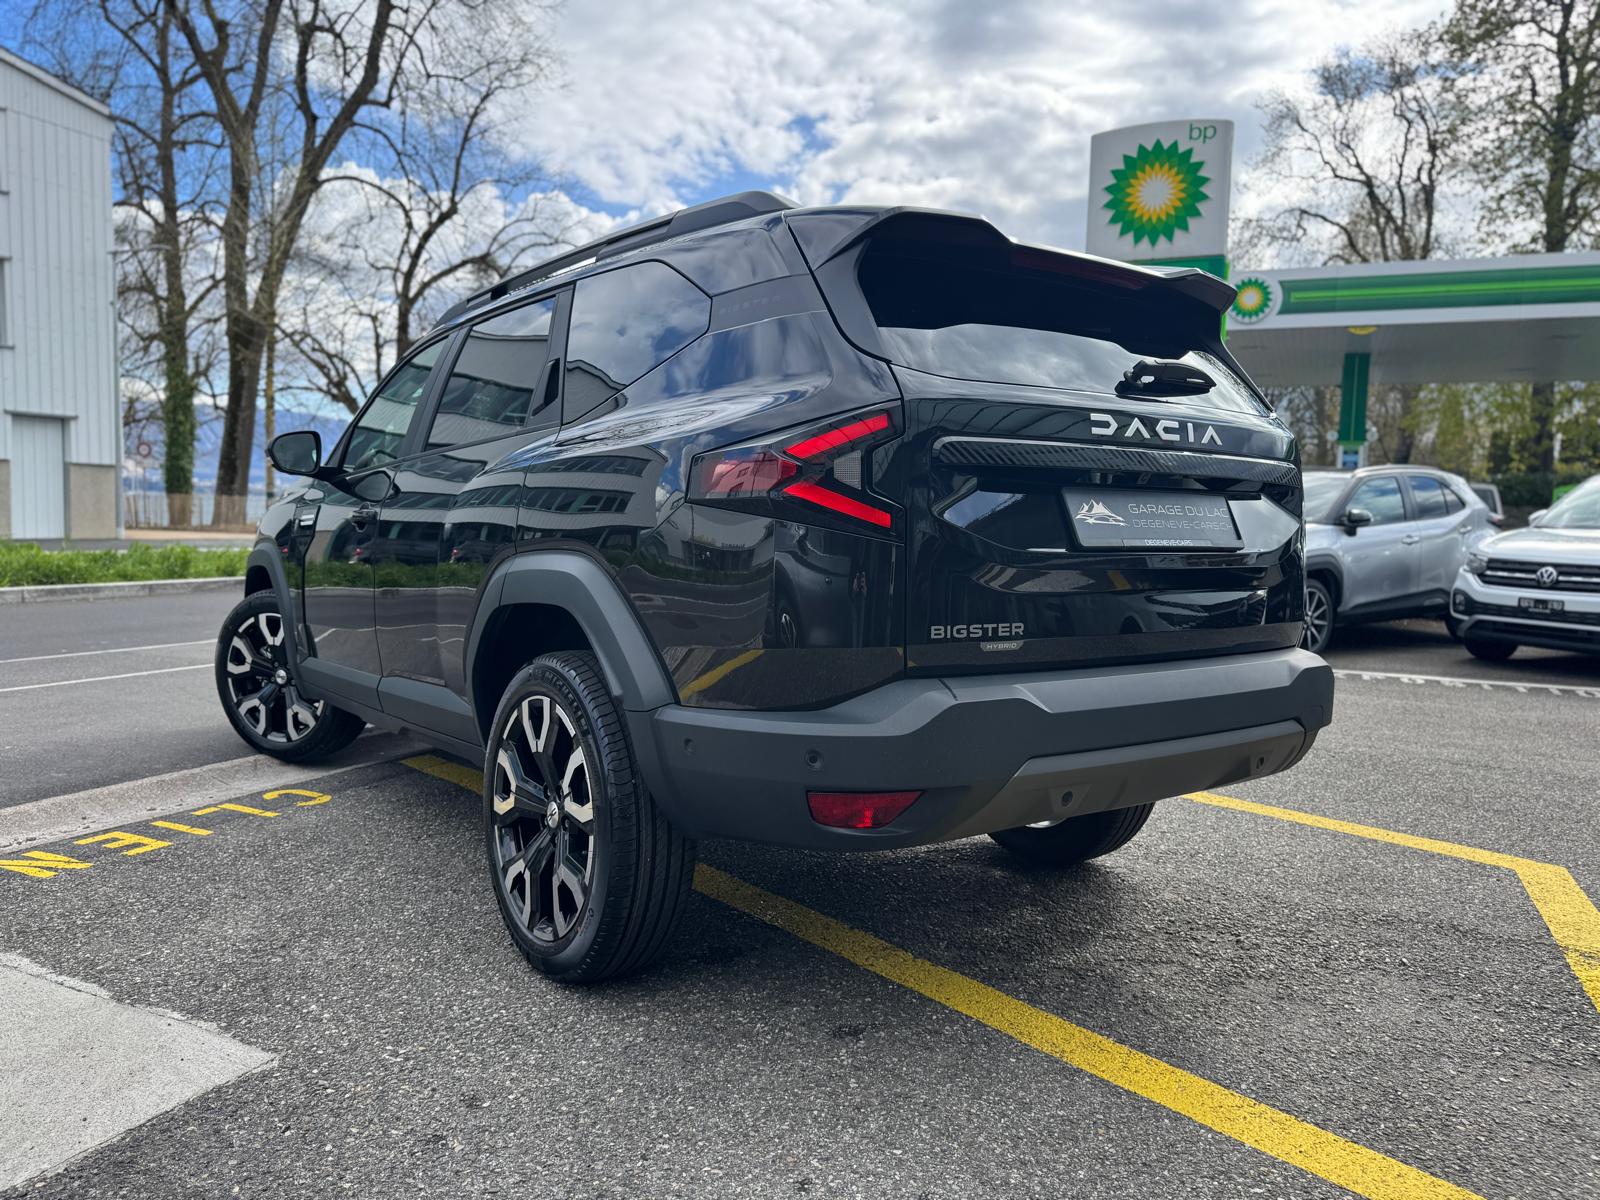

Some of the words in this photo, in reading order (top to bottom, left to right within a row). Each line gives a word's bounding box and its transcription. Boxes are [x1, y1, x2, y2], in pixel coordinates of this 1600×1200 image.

[1188, 123, 1217, 144] bp
[1090, 413, 1223, 446] DACIA
[1127, 503, 1184, 516] GARAGE
[1185, 505, 1204, 517] DU
[1205, 506, 1230, 518] LAC
[930, 622, 1025, 639] BIGSTER
[986, 642, 1017, 650] HYBRID
